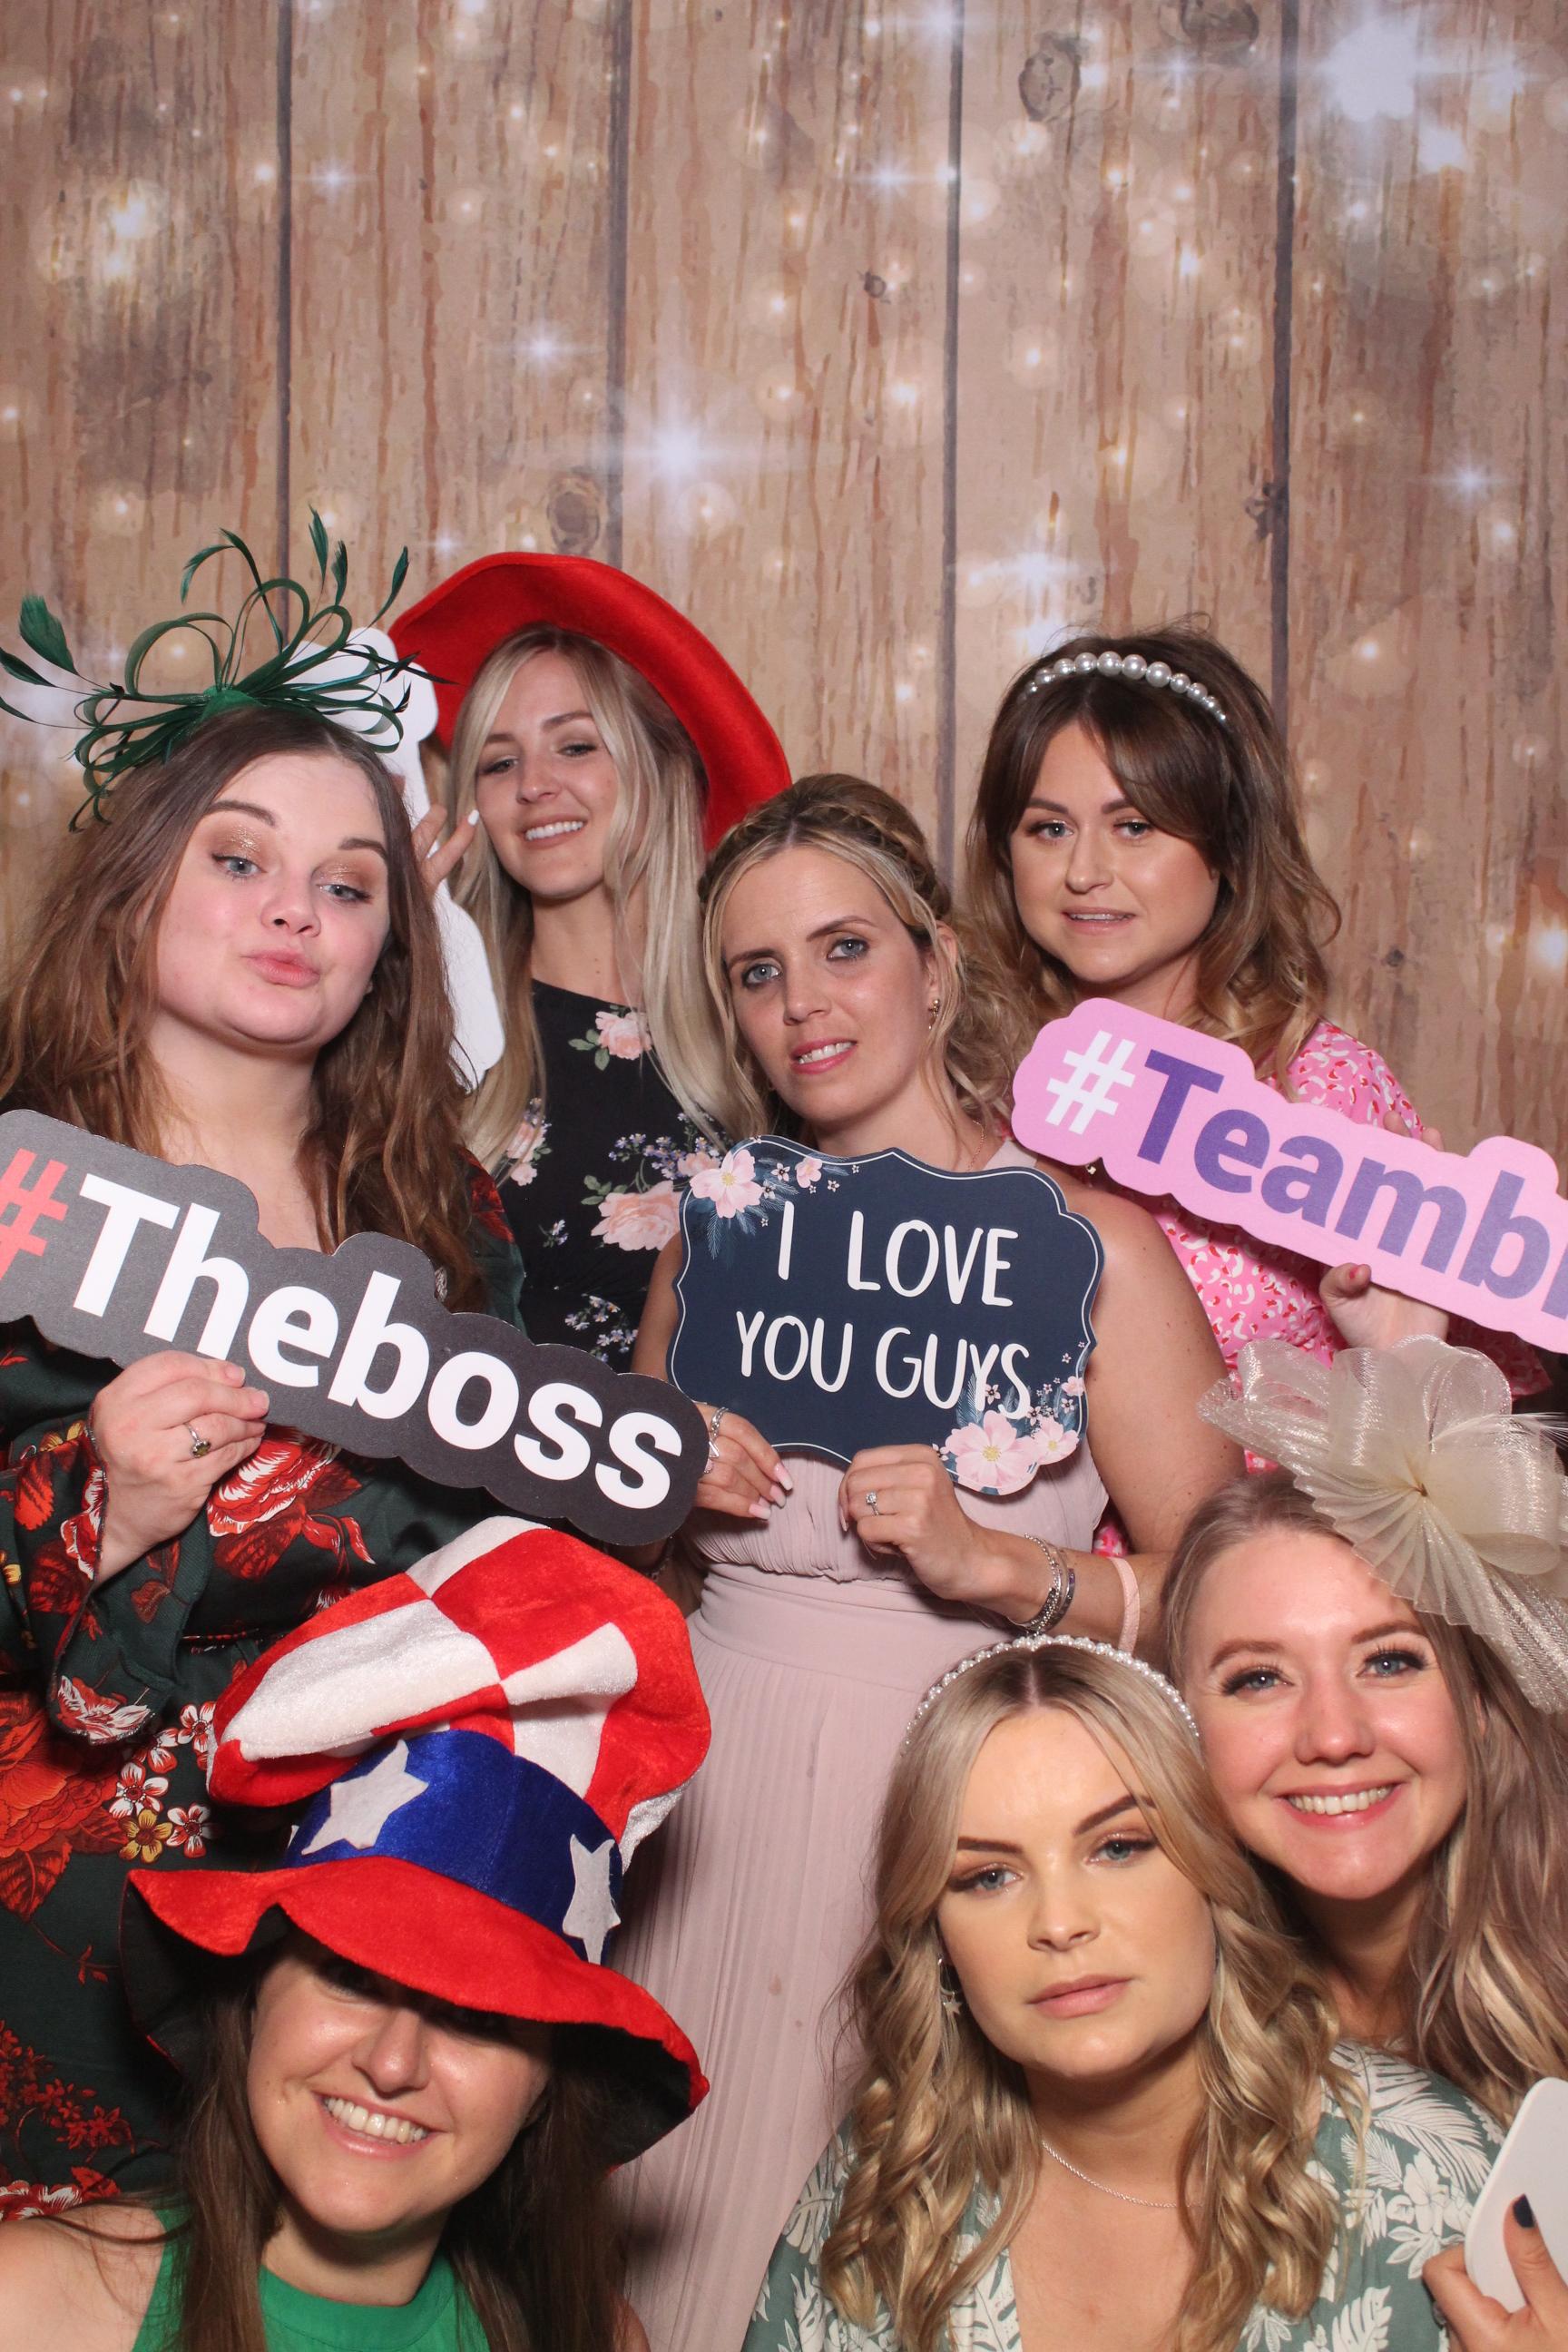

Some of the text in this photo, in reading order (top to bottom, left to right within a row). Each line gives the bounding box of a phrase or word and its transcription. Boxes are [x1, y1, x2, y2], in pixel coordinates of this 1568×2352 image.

[778, 1200, 1018, 1307] I LOVE
[0, 1148, 683, 1510] #Theboss
[736, 1310, 1032, 1420] YOU GUYS
